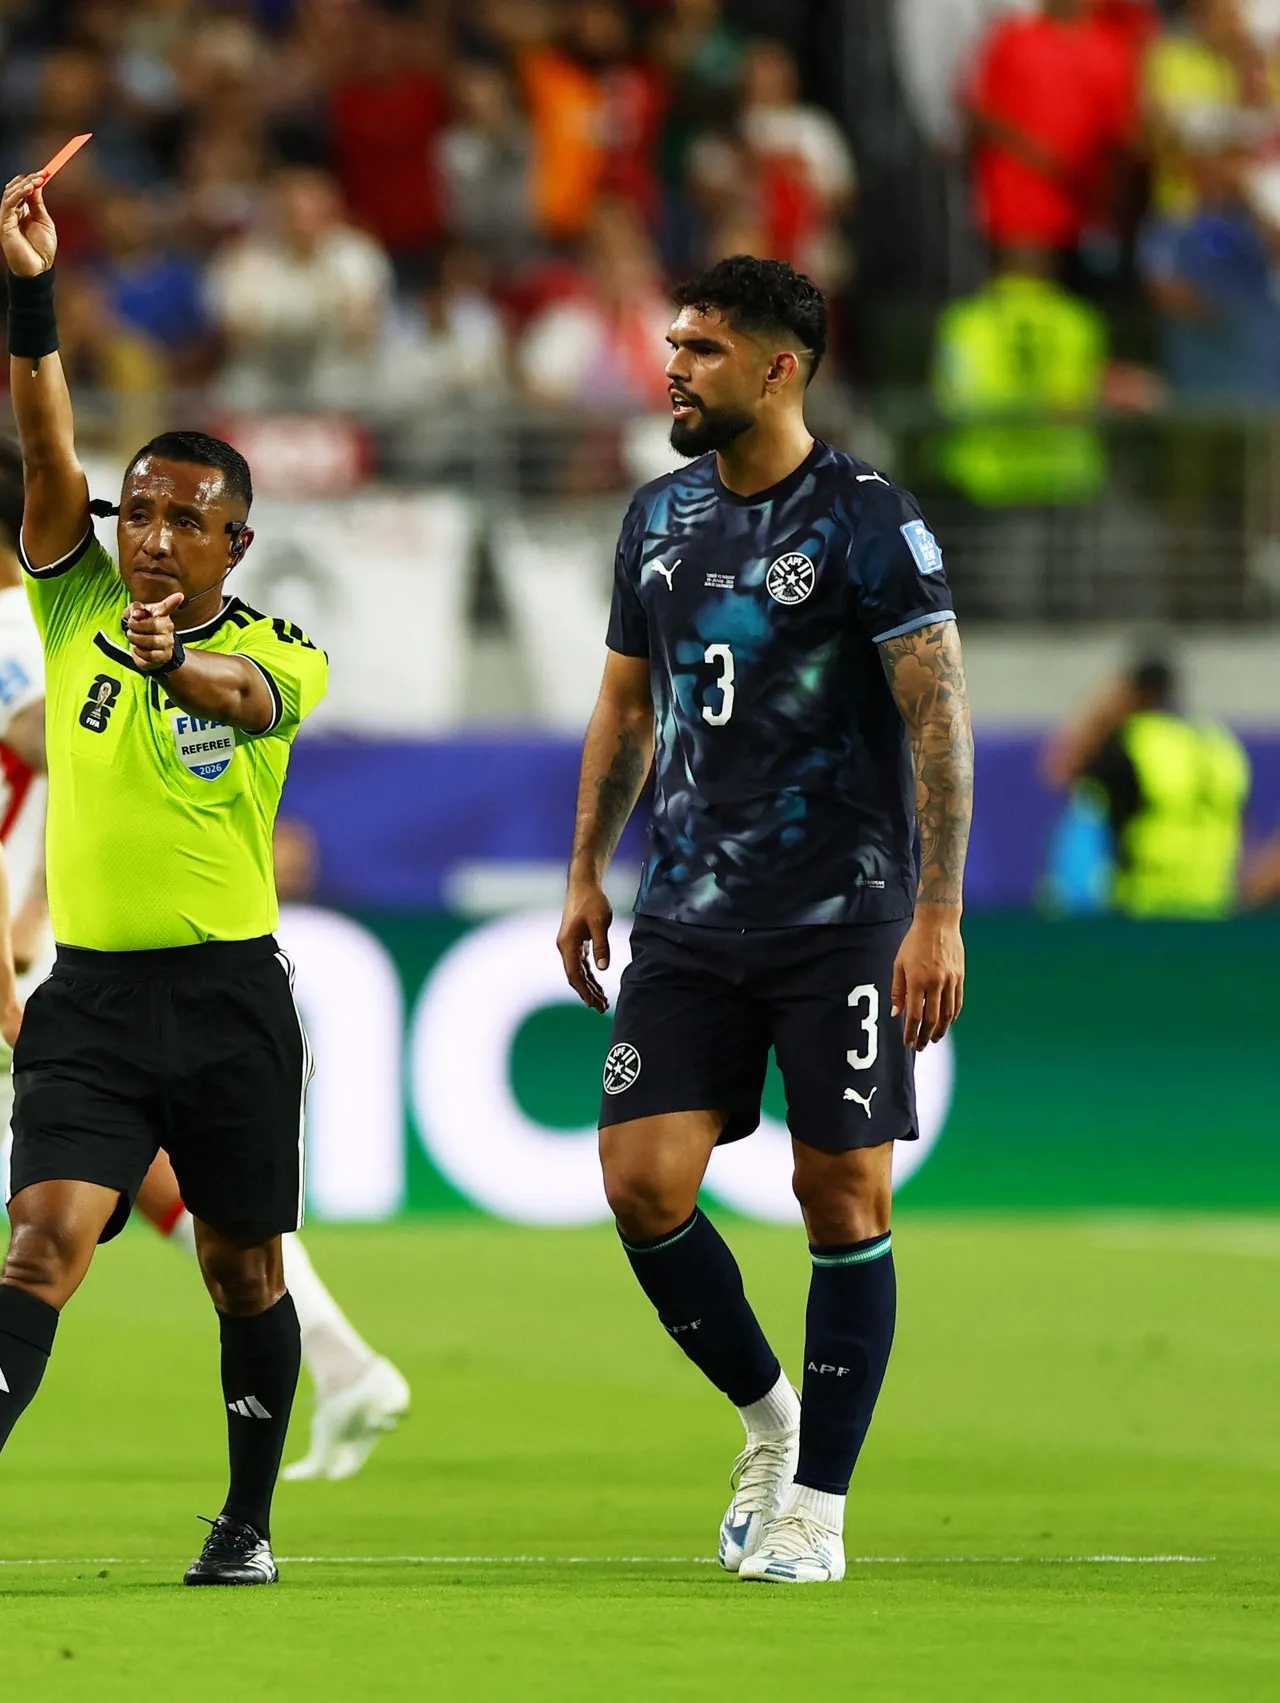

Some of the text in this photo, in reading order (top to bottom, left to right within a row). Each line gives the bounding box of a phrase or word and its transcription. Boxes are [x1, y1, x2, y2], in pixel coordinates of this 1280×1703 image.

[786, 556, 804, 567] APF
[702, 643, 735, 726] 3
[85, 716, 100, 729] FIFA
[181, 738, 231, 756] REFEREE
[200, 763, 222, 775] 2026
[846, 984, 879, 1071] 3
[807, 1361, 850, 1377] APF
